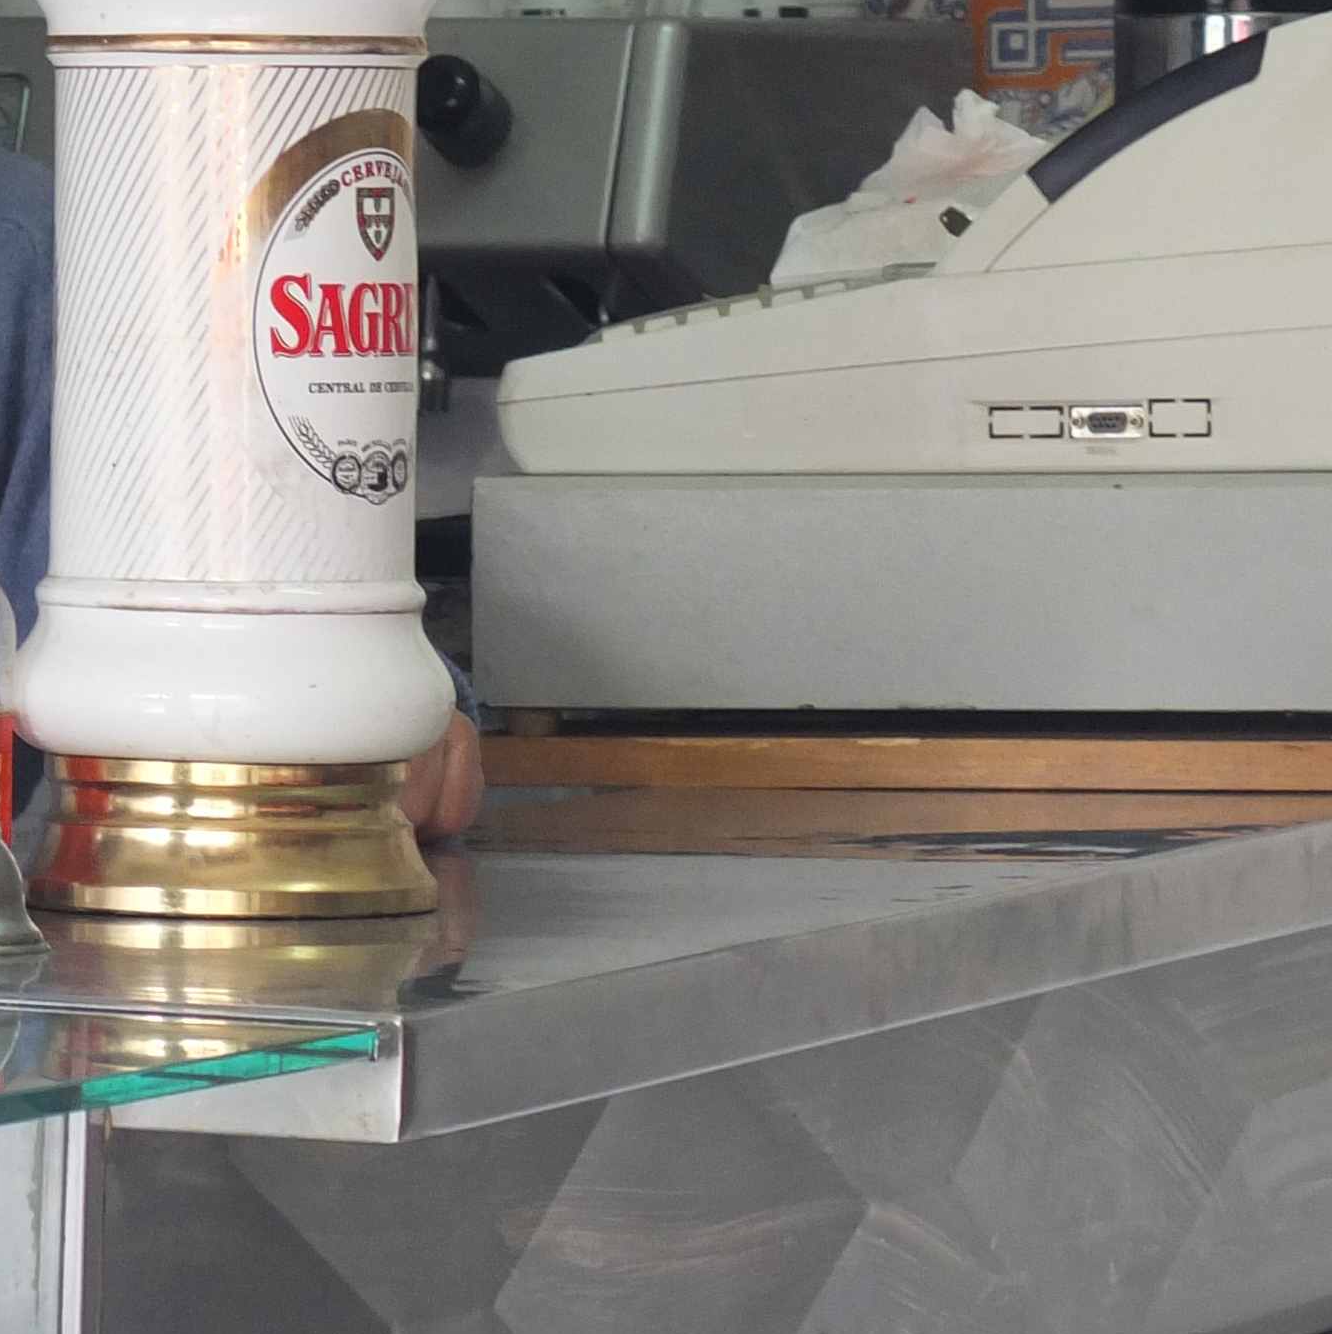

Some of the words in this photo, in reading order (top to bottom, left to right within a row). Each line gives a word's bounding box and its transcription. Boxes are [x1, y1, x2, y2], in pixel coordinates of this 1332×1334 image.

[269, 272, 416, 358] SAGRE
[308, 381, 366, 394] CENTRAL
[369, 381, 383, 393] DE
